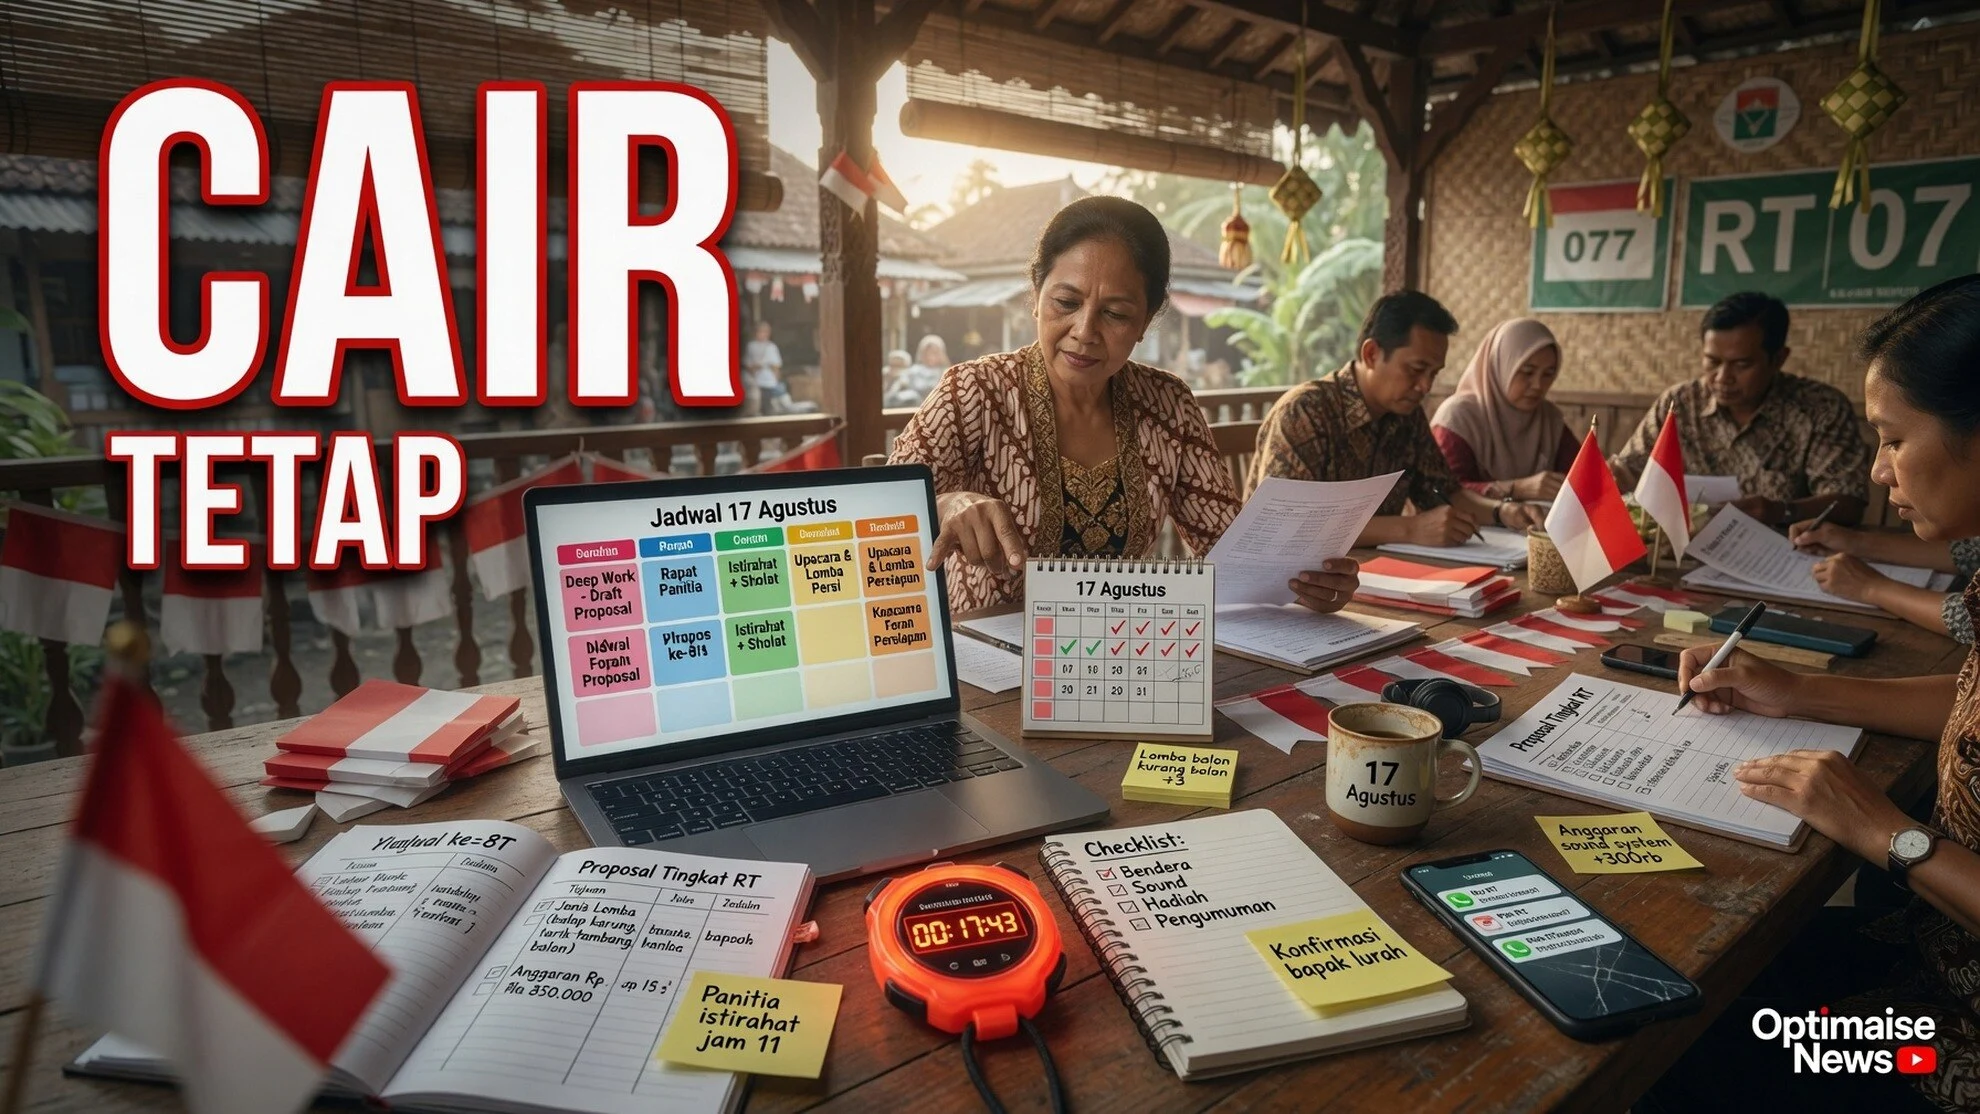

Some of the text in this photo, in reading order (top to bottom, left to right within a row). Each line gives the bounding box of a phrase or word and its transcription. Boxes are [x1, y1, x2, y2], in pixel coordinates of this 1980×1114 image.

[1700, 183, 1972, 275] RT 07
[1563, 228, 1637, 263] 077
[650, 498, 837, 528] Jadwal 17 Agustus
[602, 569, 636, 585] Work
[660, 565, 698, 581] Rapat
[590, 587, 622, 602] Draft
[1076, 581, 1167, 600] 17 Agustus
[574, 600, 633, 621] Proposal
[582, 667, 640, 688] Proposal
[1139, 749, 1187, 763] Lomba
[1137, 760, 1186, 778] kurang
[1364, 760, 1400, 787] 17
[1162, 774, 1185, 787] +3
[1346, 783, 1417, 809] Agustus
[1083, 832, 1186, 859] Checklist:
[1561, 836, 1672, 851] sound system
[1593, 851, 1663, 865] +300rb
[578, 860, 762, 889] Proposal Tingkat RT
[1119, 860, 1193, 879] Bendera
[1131, 874, 1188, 894] Sound
[1141, 889, 1209, 911] Hadiah
[1154, 899, 1277, 929] Pengumuman
[912, 911, 1019, 948] 00:17:43
[1269, 927, 1382, 961] Konfirmasi
[1284, 943, 1408, 981] bapak lurah
[510, 965, 580, 983] Anggaran
[701, 985, 780, 1010] Panitia
[699, 1007, 801, 1033] istirahat
[696, 1030, 781, 1054] jam 11
